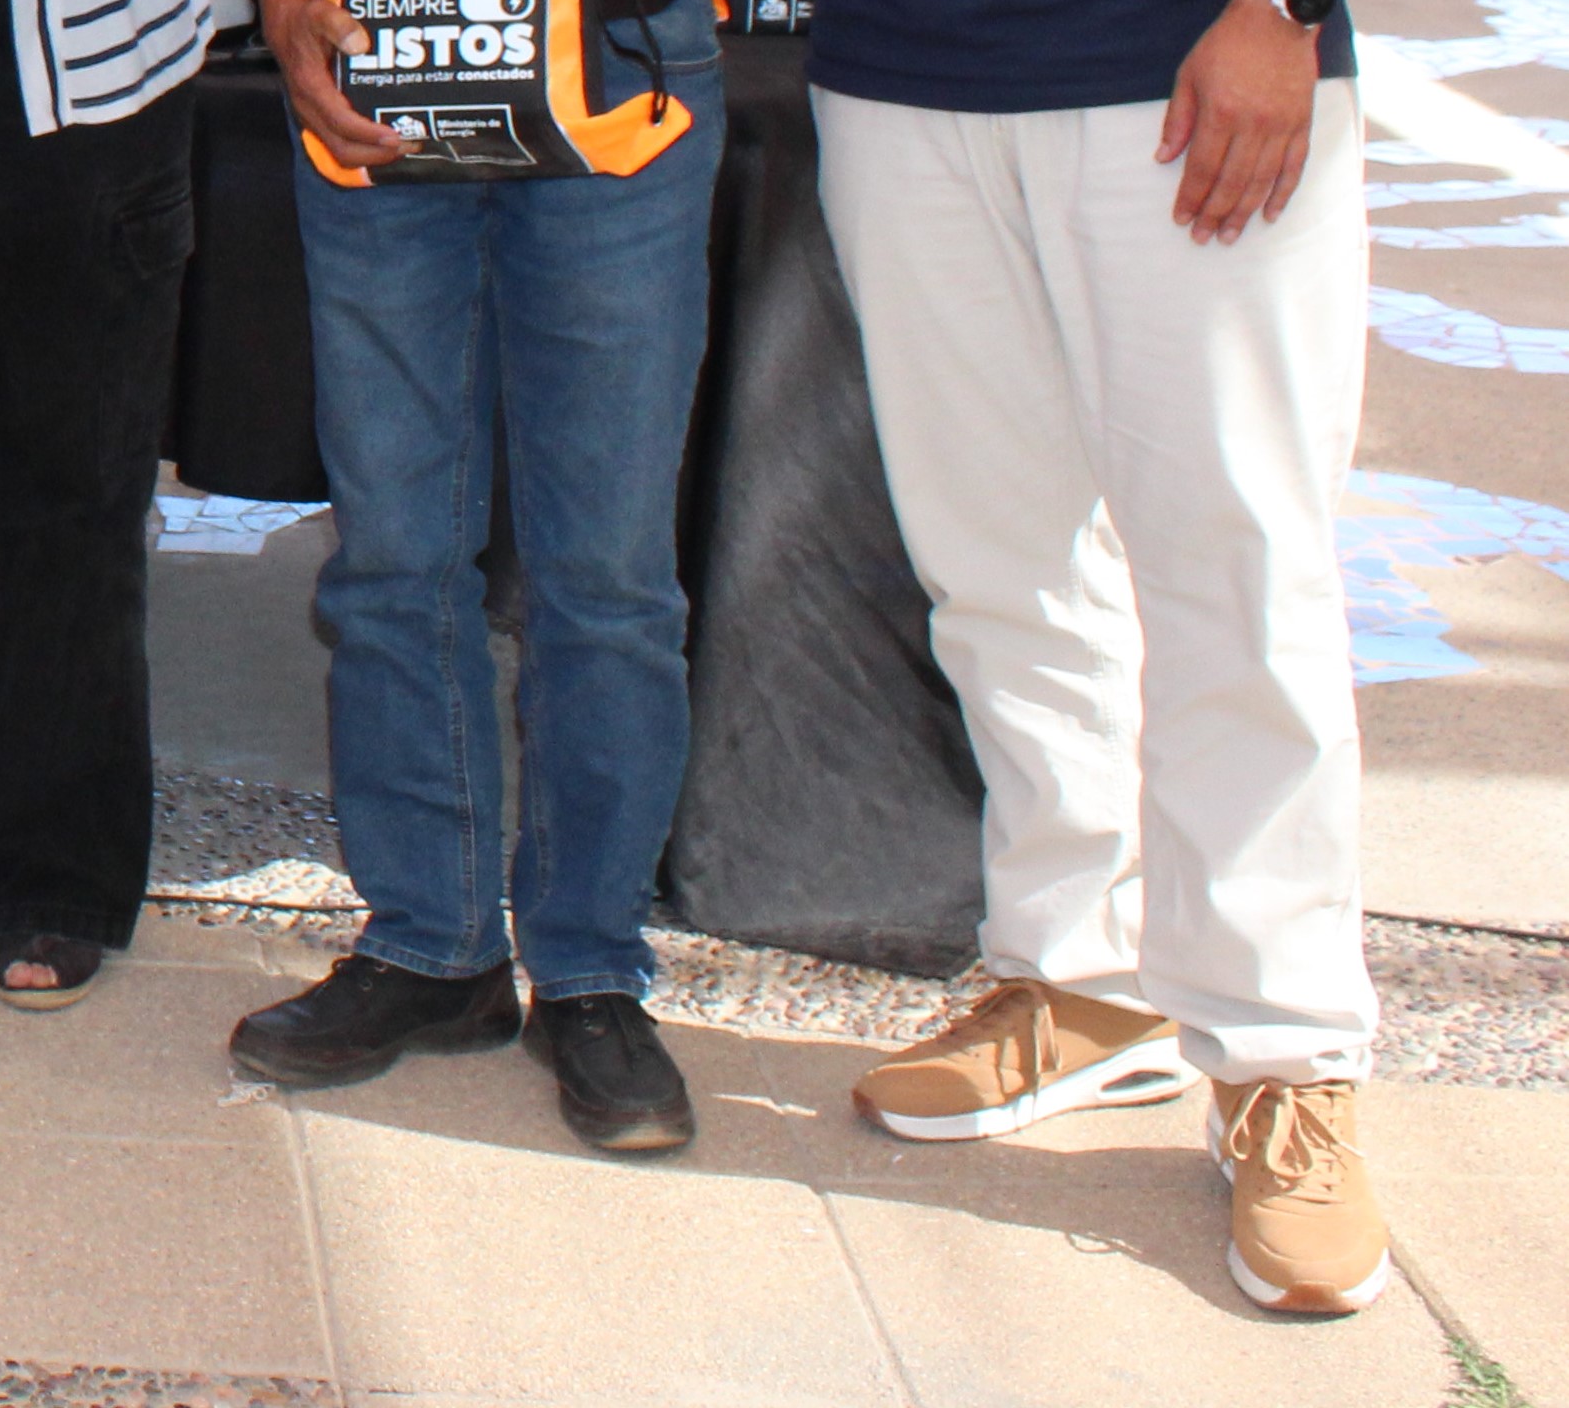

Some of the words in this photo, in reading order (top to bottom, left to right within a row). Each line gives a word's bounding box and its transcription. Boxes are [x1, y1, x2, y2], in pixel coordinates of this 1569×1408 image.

[350, 72, 393, 87] Energía
[396, 73, 423, 86] para
[425, 71, 455, 82] estar
[456, 67, 535, 82] conectados
